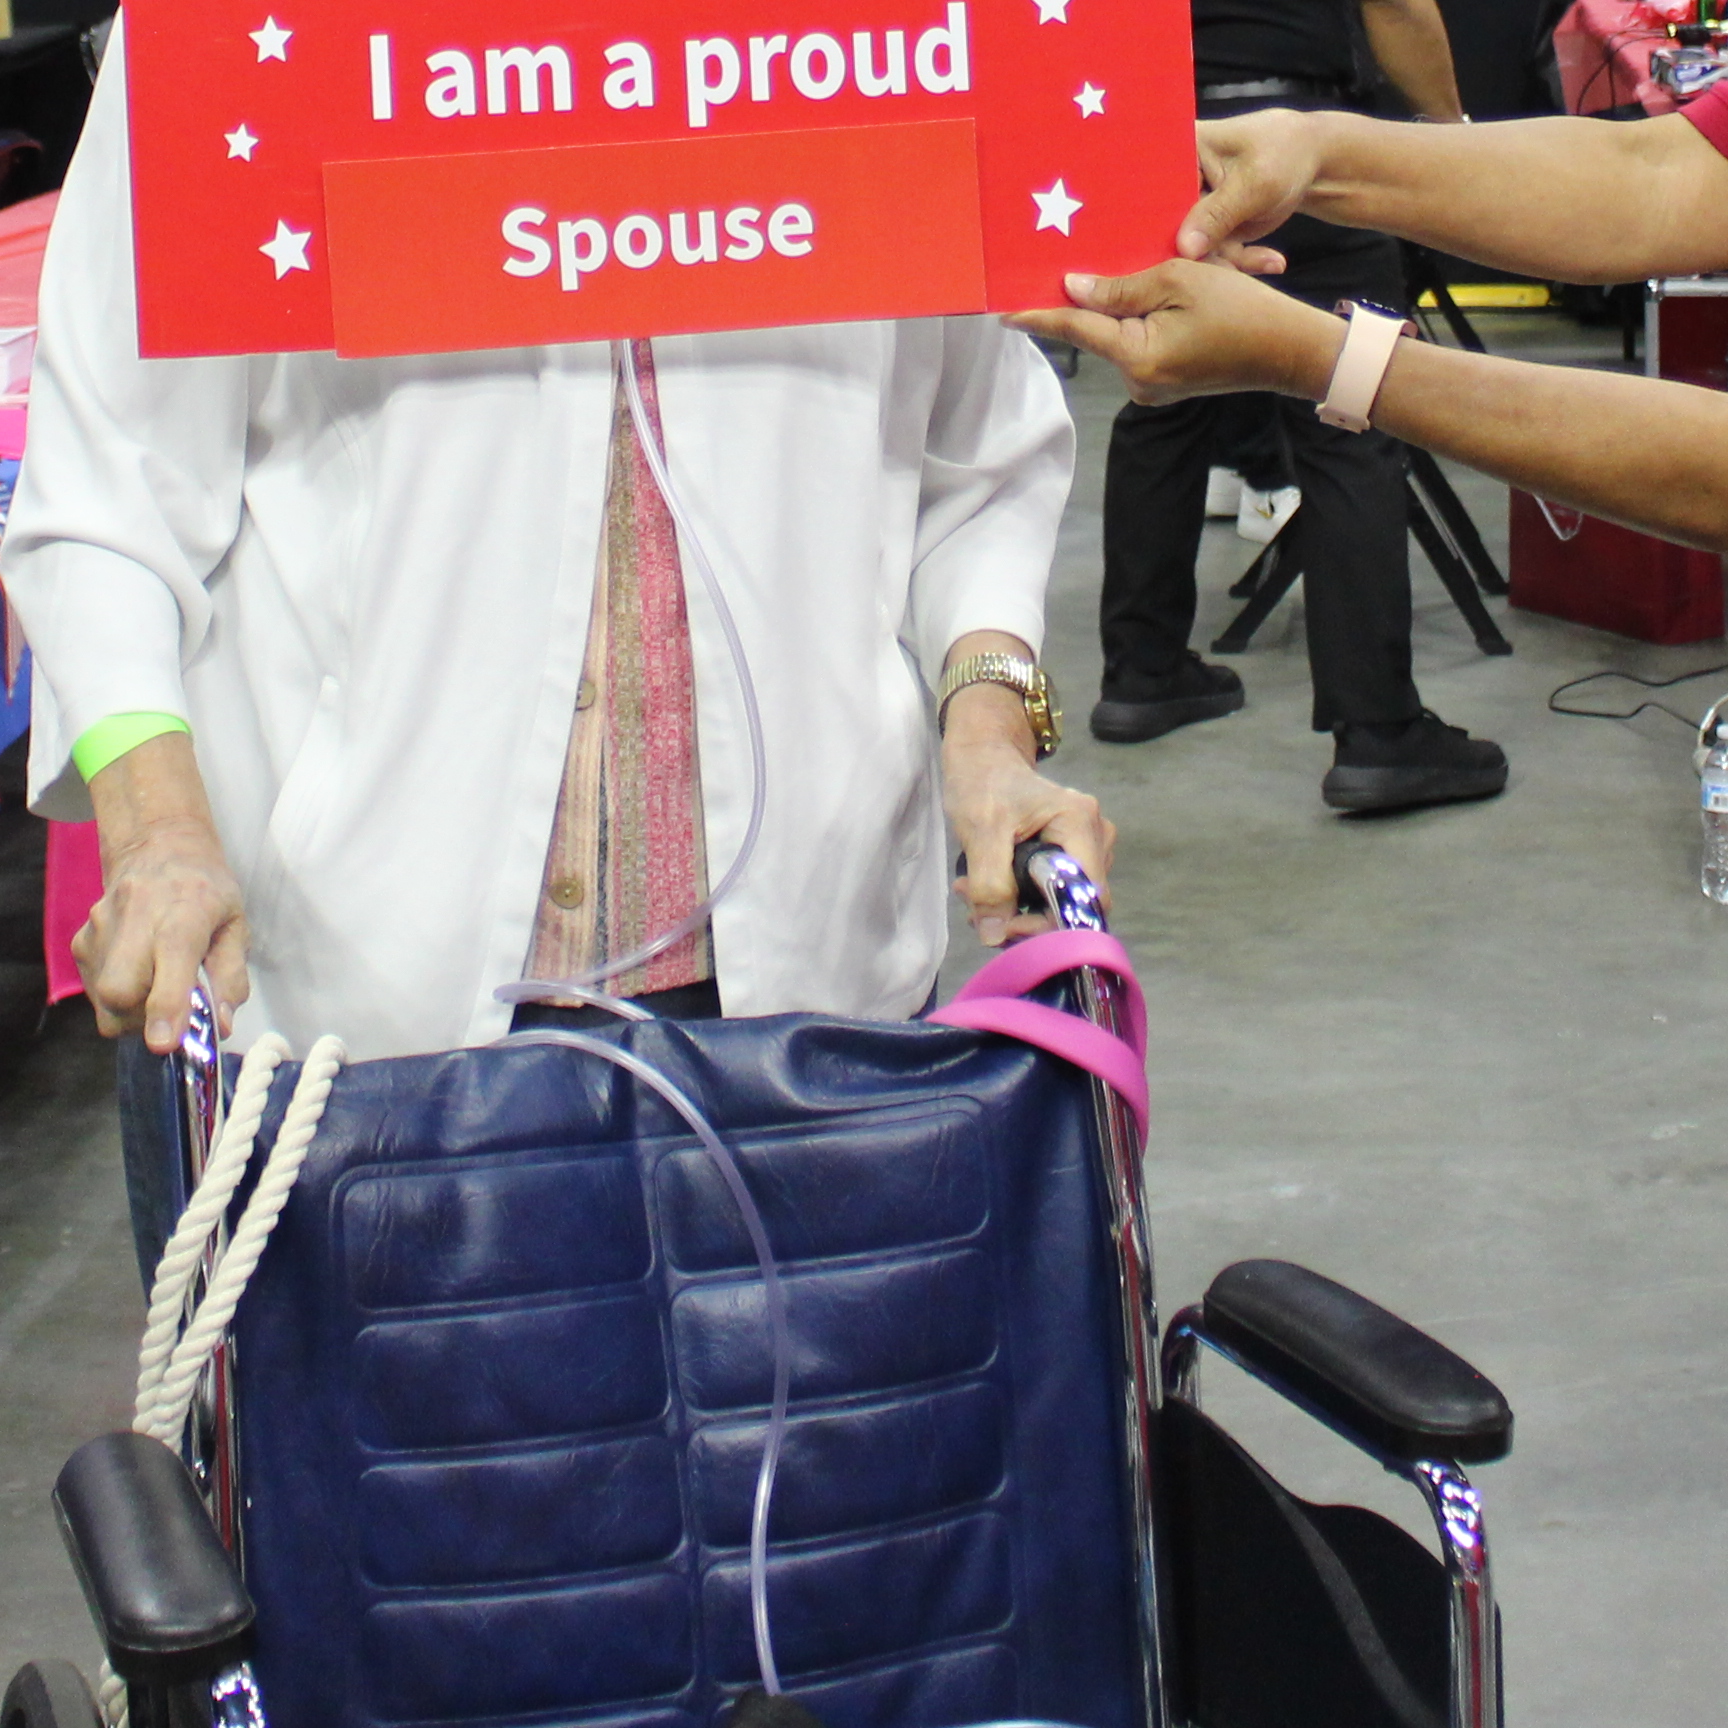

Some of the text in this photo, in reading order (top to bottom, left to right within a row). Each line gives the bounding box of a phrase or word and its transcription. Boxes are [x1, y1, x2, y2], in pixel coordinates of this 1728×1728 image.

[367, 1, 972, 128] I am a proud
[499, 201, 816, 292] Spouse
